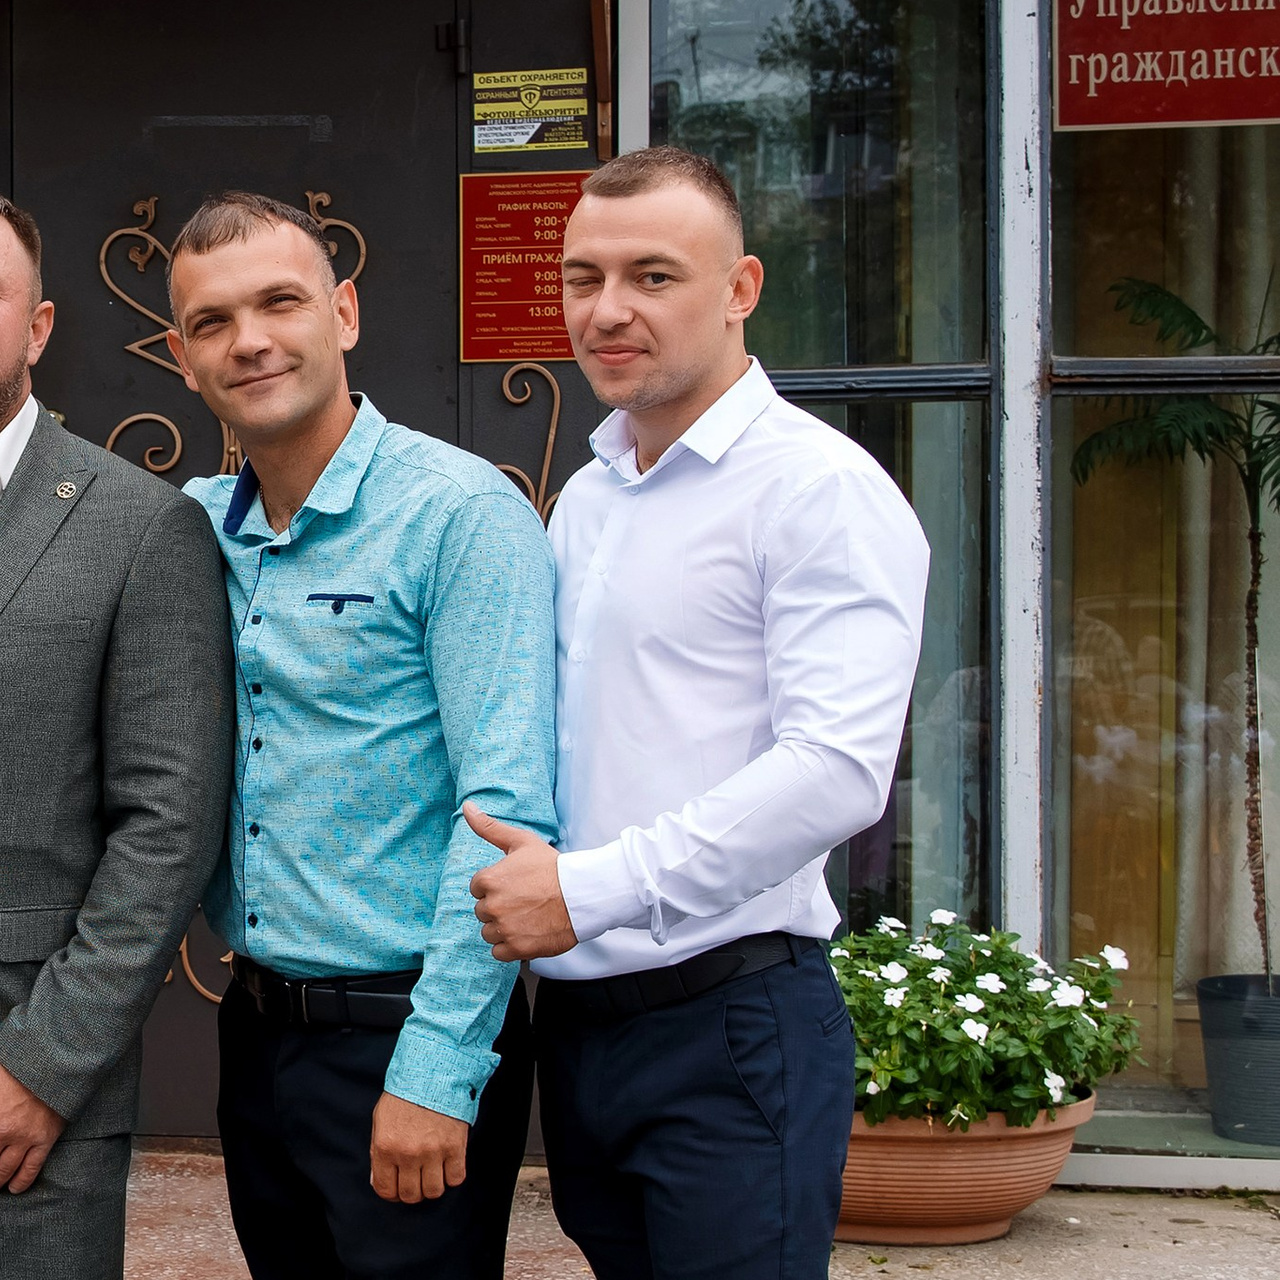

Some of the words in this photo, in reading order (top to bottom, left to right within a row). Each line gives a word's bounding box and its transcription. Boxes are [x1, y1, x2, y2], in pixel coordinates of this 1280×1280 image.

[1068, 45, 1280, 98] гражданск
[478, 75, 518, 84] ОБЪЕКТ
[520, 72, 584, 82] ОХРАНЯЕТСЯ
[475, 91, 518, 100] ОХРАННЫМ
[542, 88, 584, 97] АГЕНТСТВОМ
[497, 203, 531, 211] ГРАФИК
[532, 202, 569, 210] РАБОТЫ:
[534, 216, 569, 226] 9:00-1
[482, 252, 523, 264] ПРИЁМ
[524, 253, 563, 264] ГРАЖД
[534, 271, 563, 281] 9:00-
[534, 284, 563, 295] 9:00-
[528, 306, 562, 317] 13:00-
